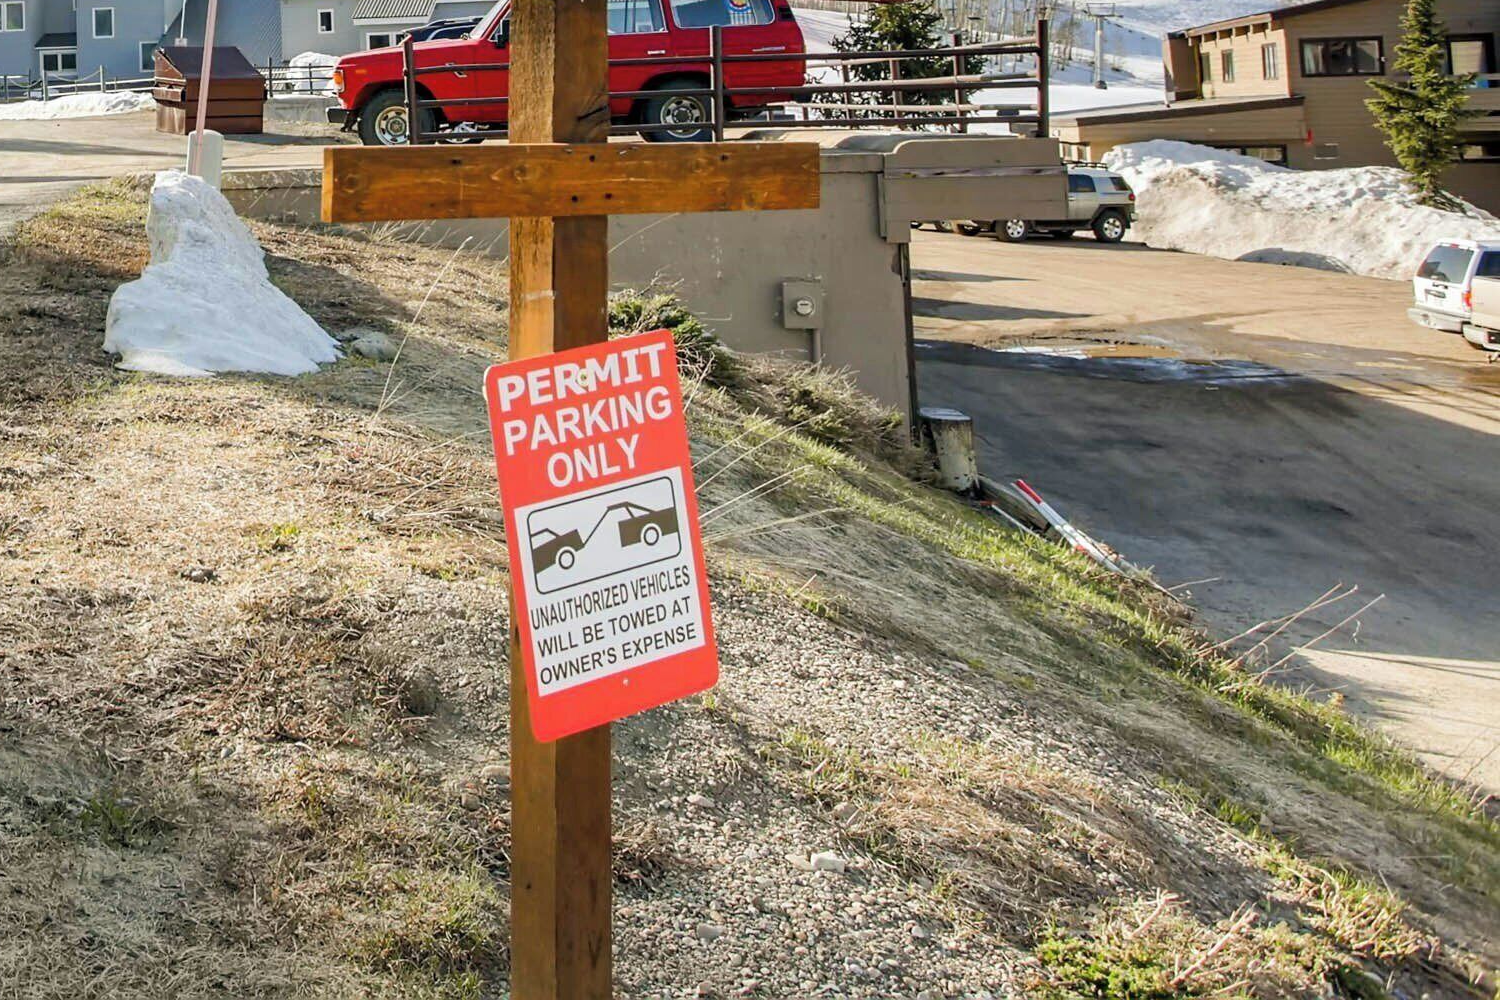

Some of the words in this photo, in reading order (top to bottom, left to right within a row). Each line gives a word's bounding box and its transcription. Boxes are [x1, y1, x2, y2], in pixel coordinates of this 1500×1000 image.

[497, 342, 666, 412] PERMIT
[503, 386, 672, 456] PARKING
[547, 433, 640, 487] ONLY
[530, 583, 629, 630] UNAUTHORIZED
[630, 565, 691, 600] VEHICLES
[538, 631, 579, 657] WILL
[582, 622, 605, 644] BE
[608, 604, 667, 636] TOWED
[671, 596, 691, 618] AT
[540, 647, 618, 685] OWNER'S
[622, 622, 697, 660] EXPENSE
